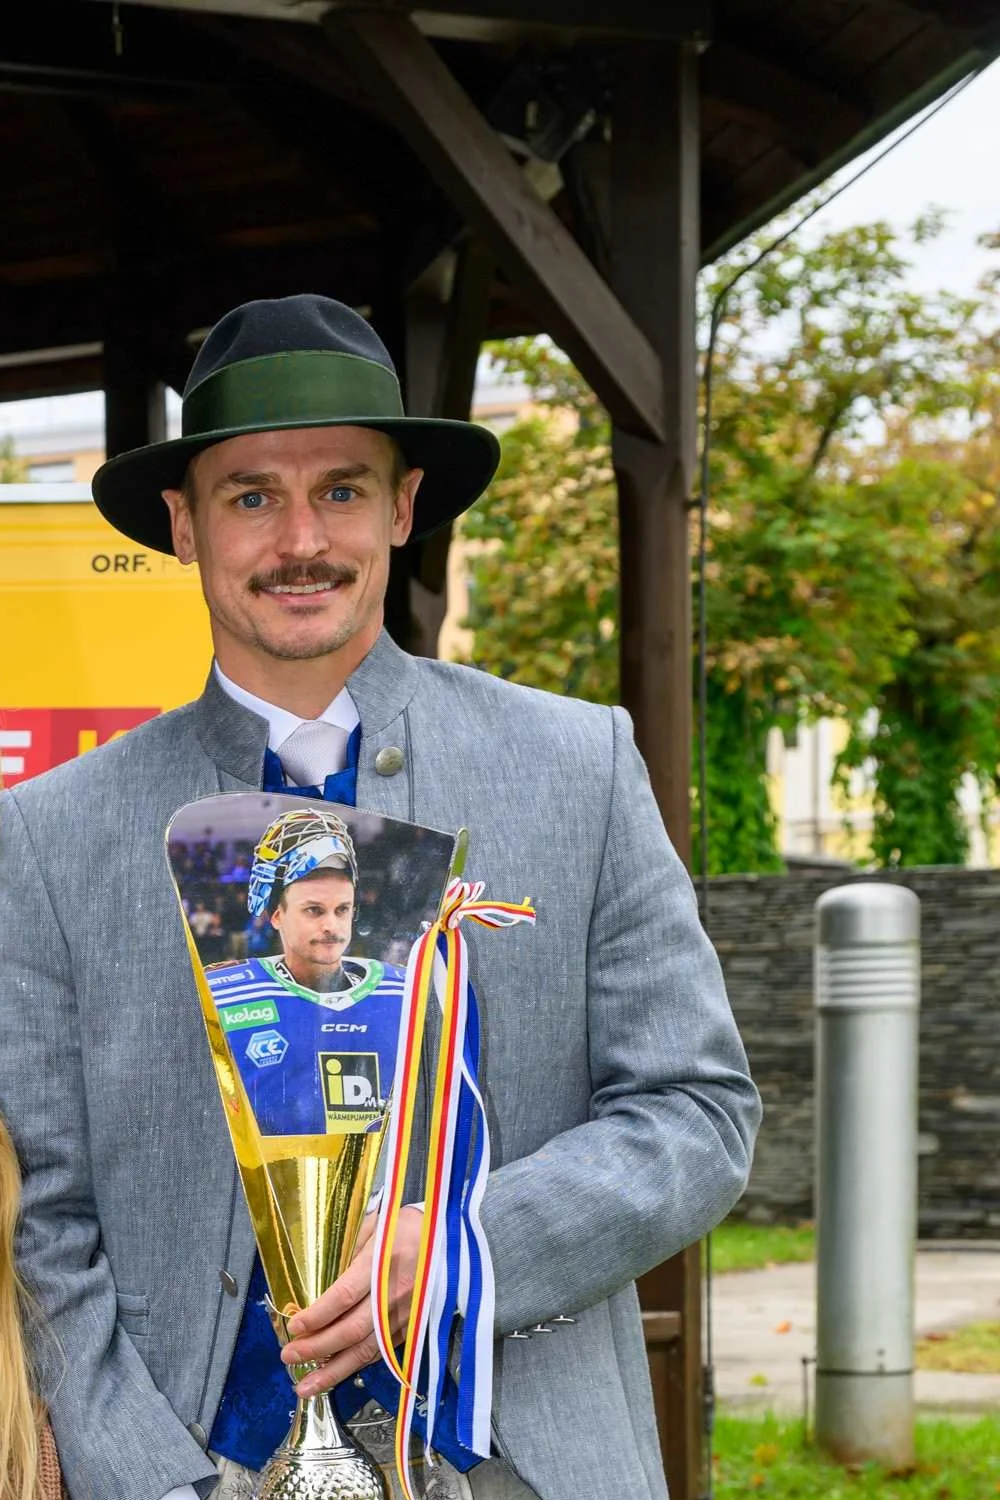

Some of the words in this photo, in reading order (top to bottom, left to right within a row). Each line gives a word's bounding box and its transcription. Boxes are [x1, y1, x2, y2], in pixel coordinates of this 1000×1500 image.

[92, 554, 151, 573] ORF.
[223, 1007, 274, 1025] kelag
[321, 1023, 368, 1033] CCM
[251, 1038, 284, 1059] ICE
